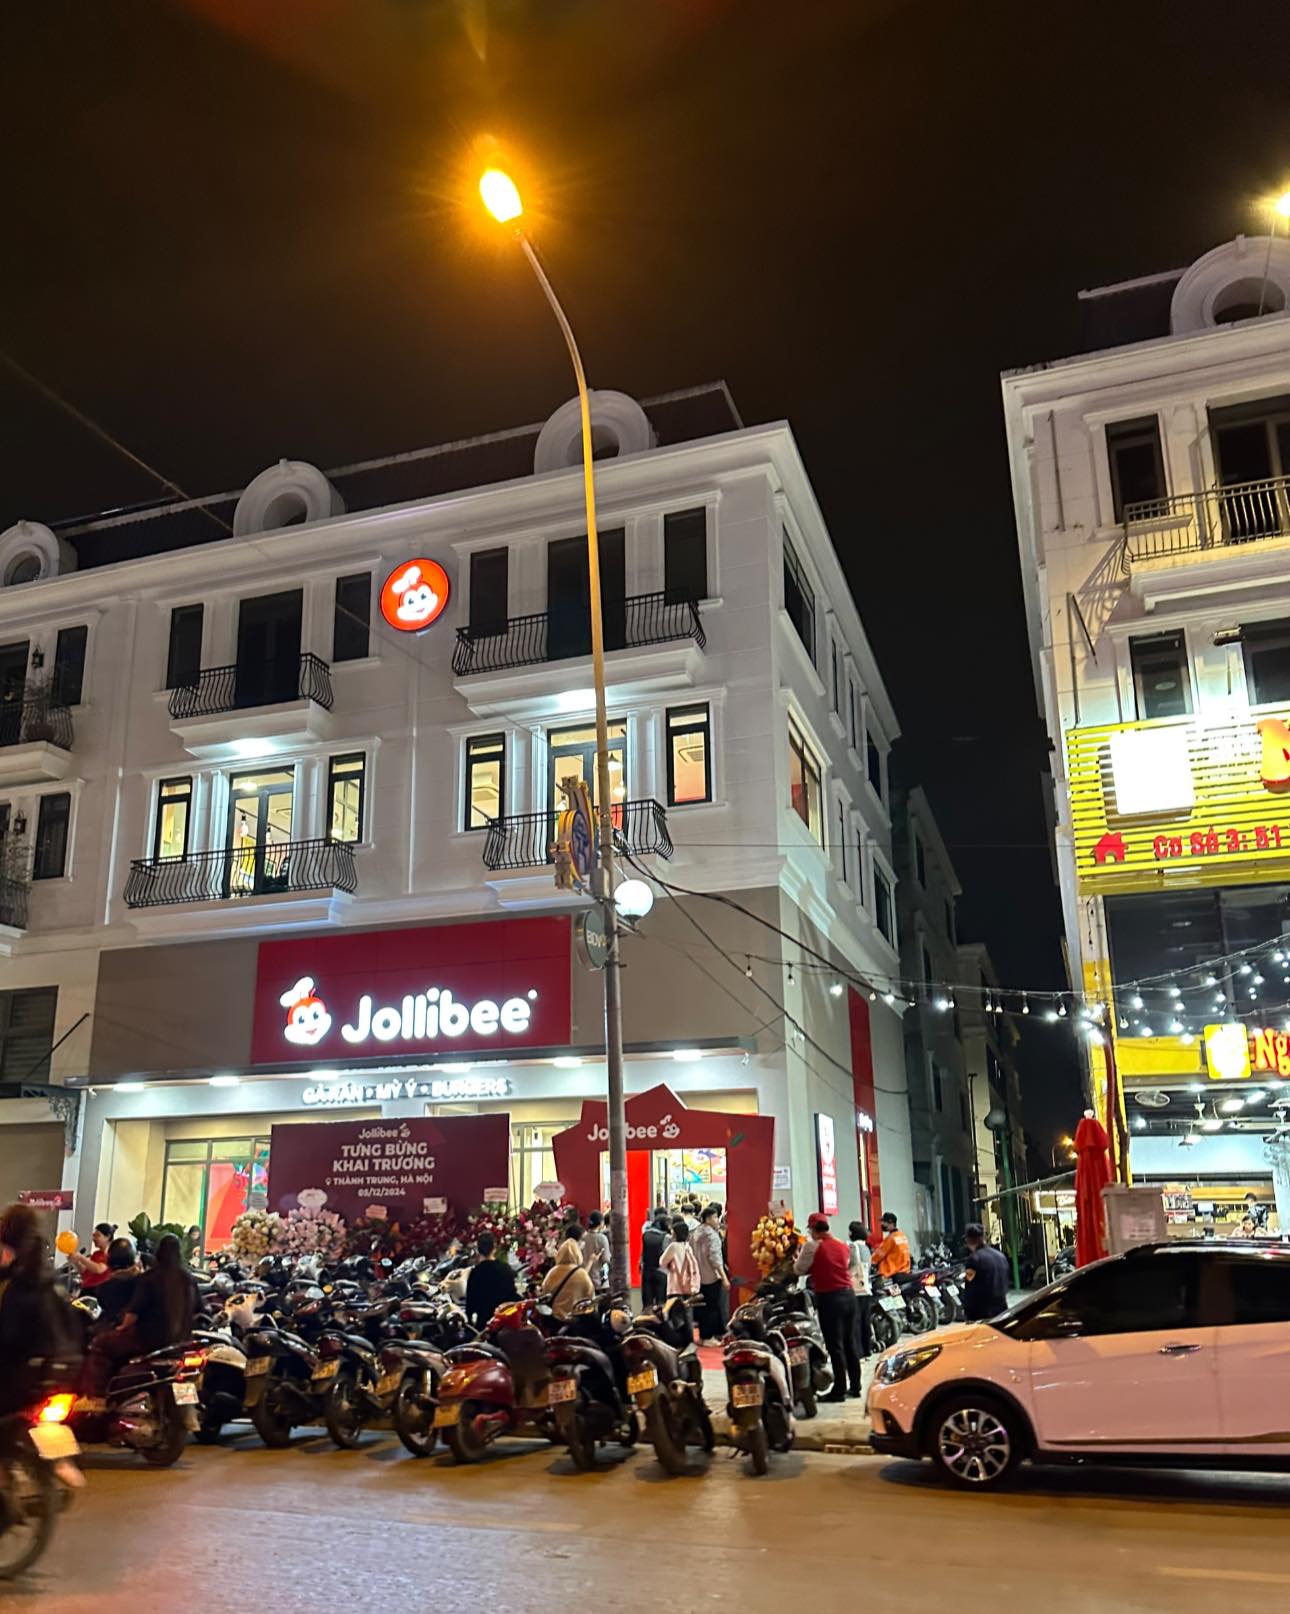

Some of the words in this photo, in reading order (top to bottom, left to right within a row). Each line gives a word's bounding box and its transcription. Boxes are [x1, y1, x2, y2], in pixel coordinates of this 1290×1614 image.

[341, 987, 533, 1043] Jollibee
[358, 1127, 399, 1139] Jollibee
[333, 1159, 369, 1172] KHAI
[401, 1173, 414, 1183] HÀ
[416, 1173, 433, 1184] NỘI
